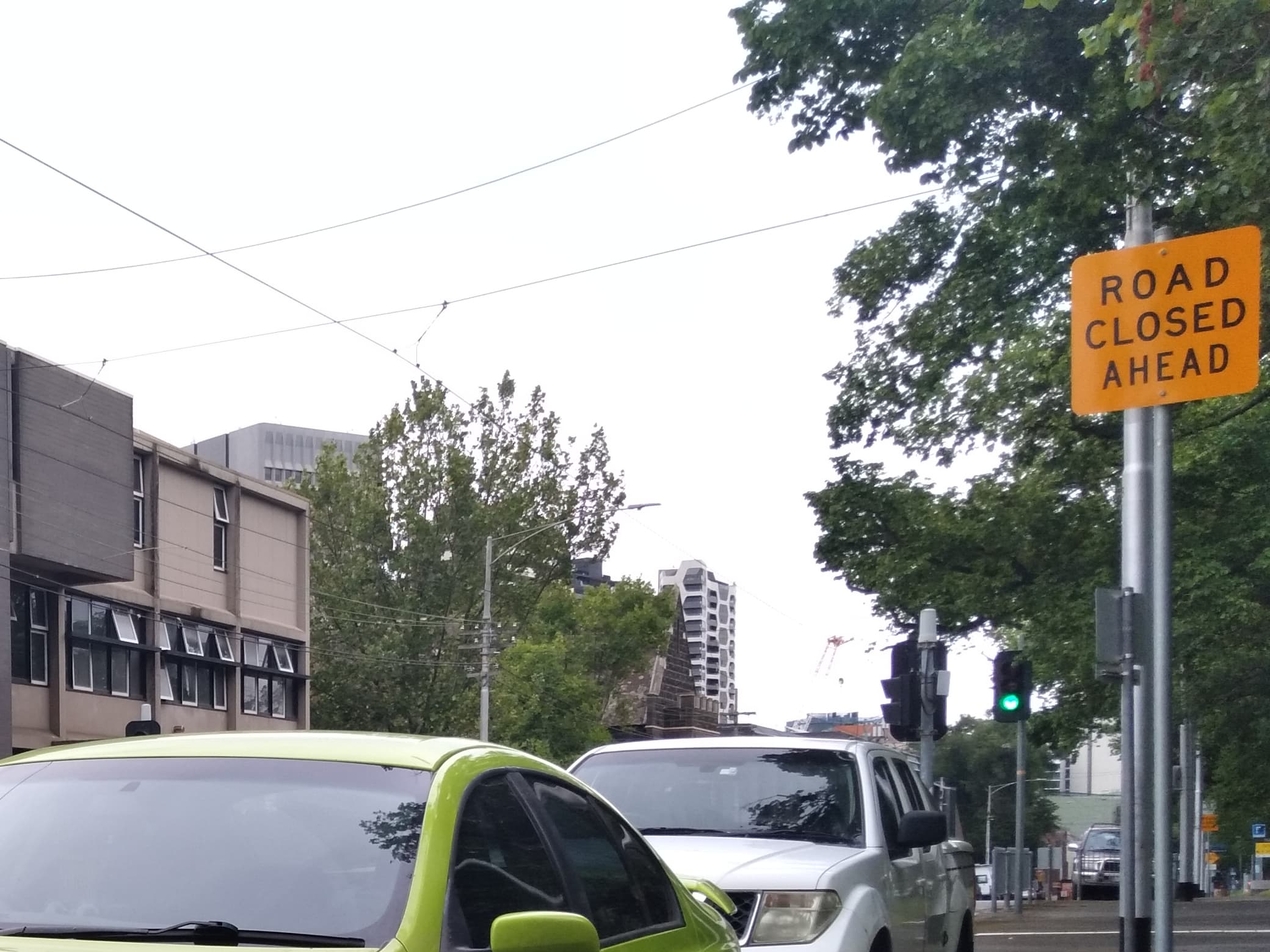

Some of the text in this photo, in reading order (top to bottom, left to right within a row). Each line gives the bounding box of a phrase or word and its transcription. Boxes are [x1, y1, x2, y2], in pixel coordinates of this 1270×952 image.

[1101, 256, 1229, 306] ROAD
[1085, 297, 1246, 350] CLOSED
[1102, 343, 1229, 390] AHEAD
